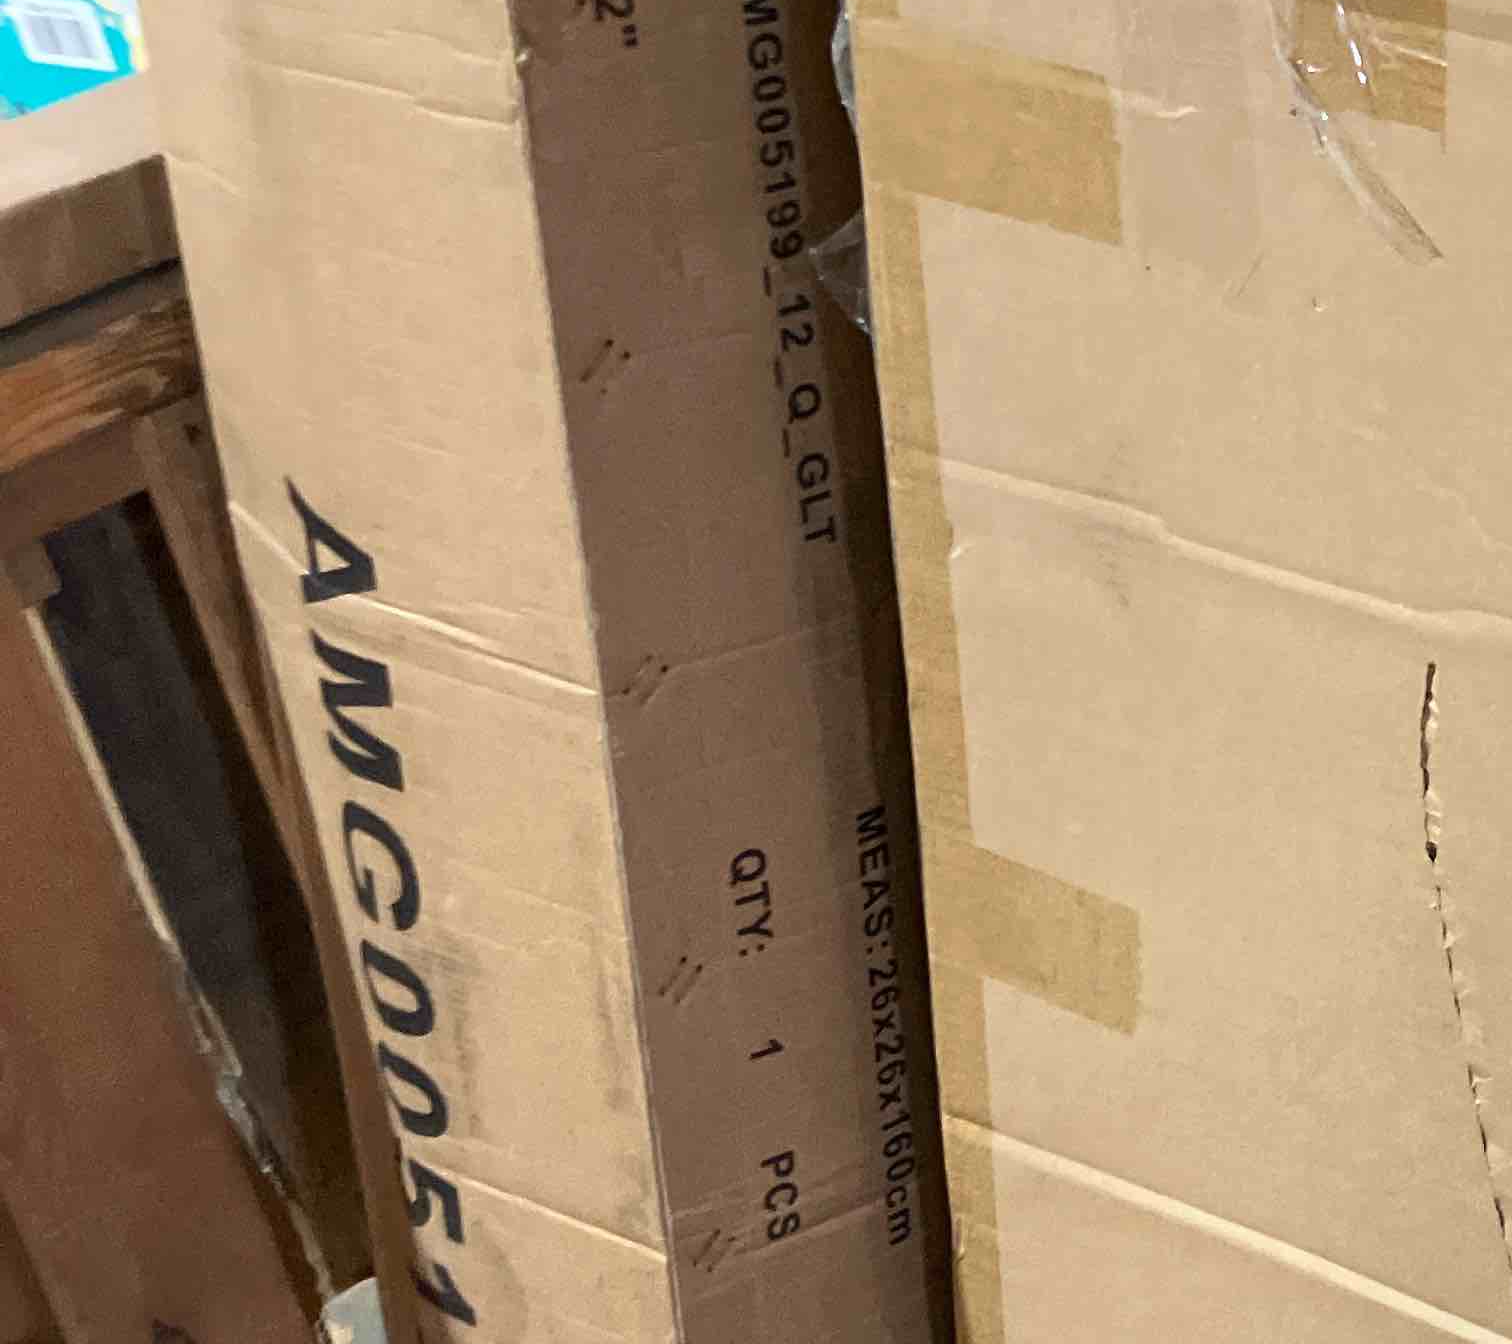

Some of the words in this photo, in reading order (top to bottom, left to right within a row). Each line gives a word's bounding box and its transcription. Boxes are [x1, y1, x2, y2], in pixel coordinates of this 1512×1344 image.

[729, 847, 773, 957] QTY:
[749, 1038, 784, 1062] 1
[760, 1150, 801, 1242] PCS
